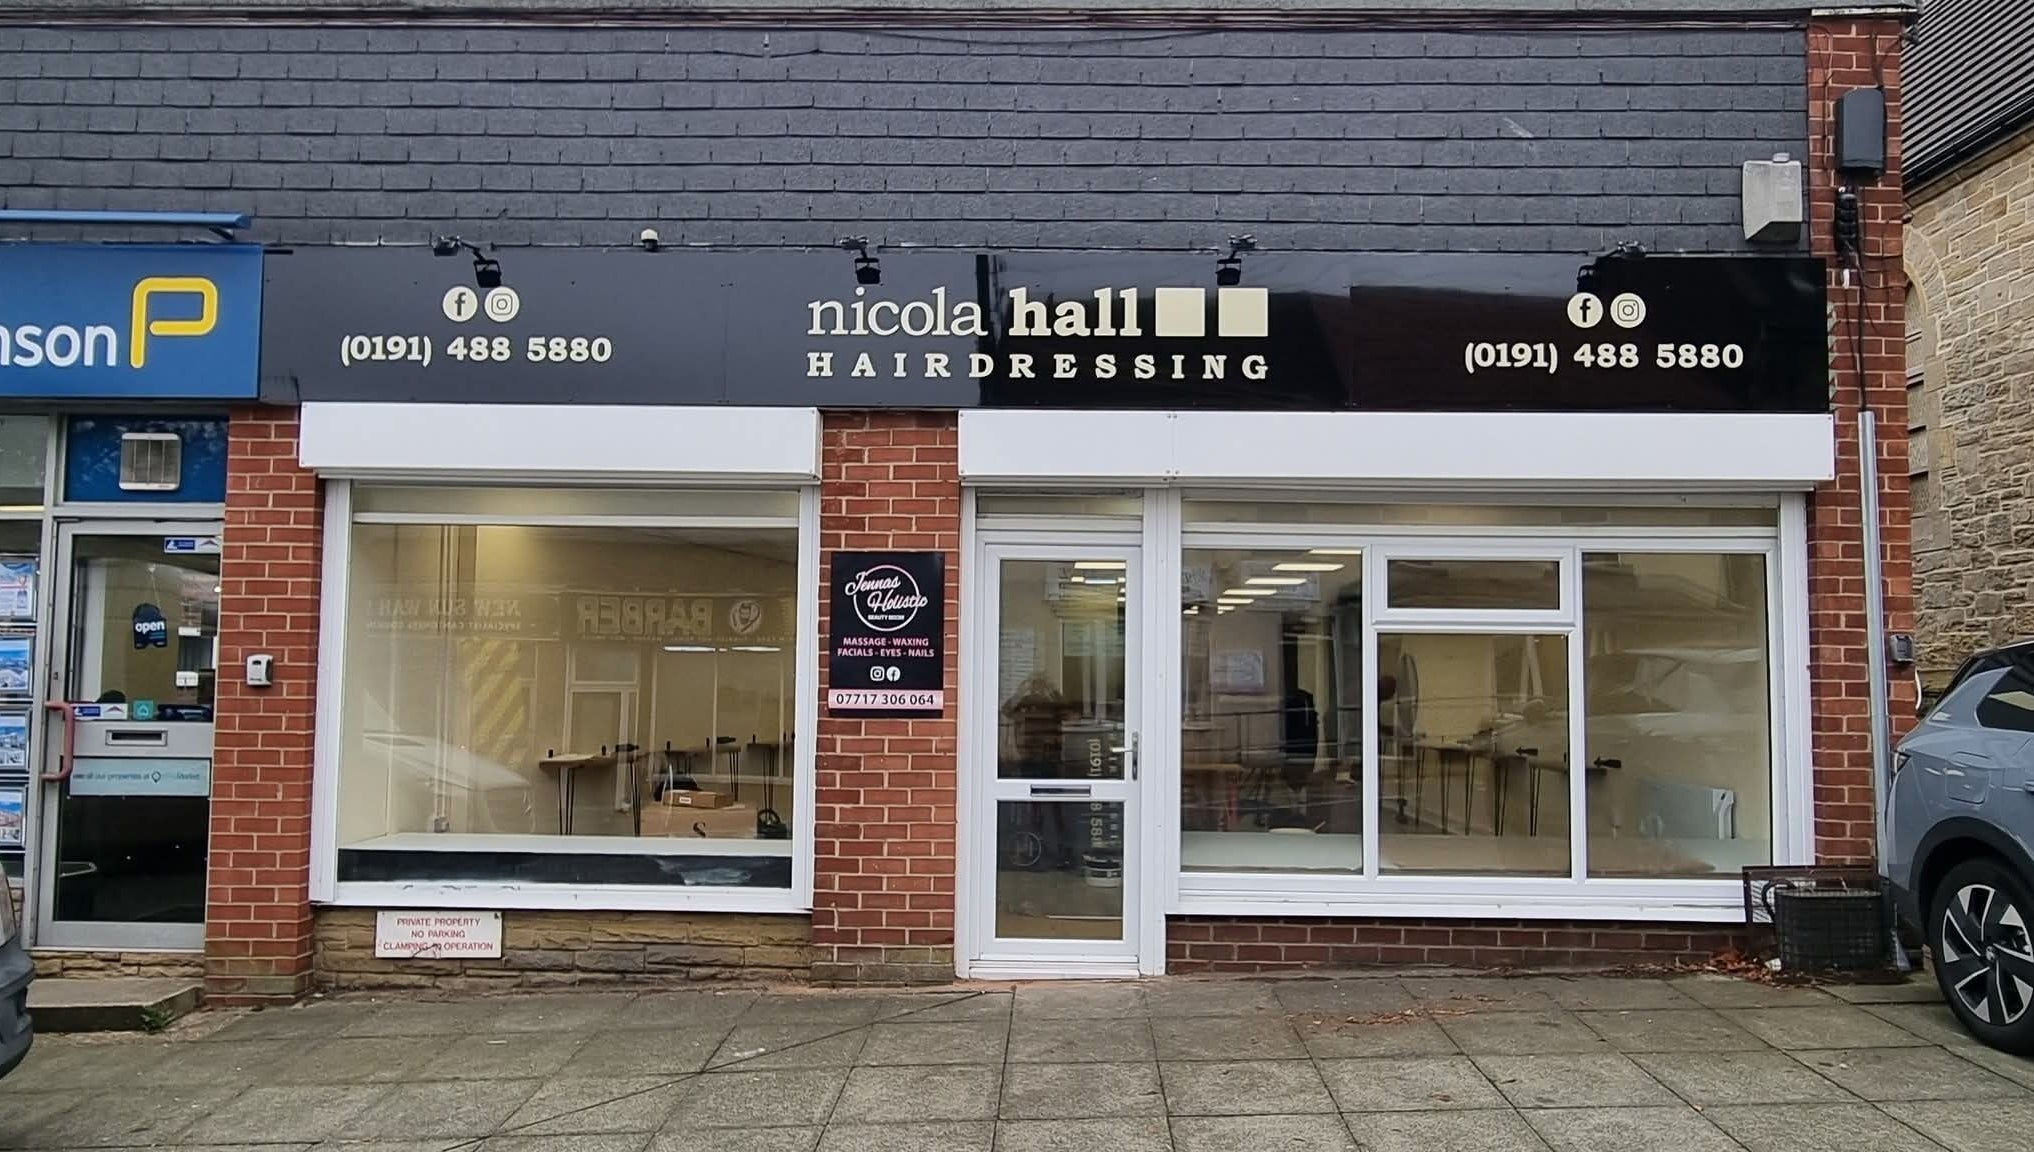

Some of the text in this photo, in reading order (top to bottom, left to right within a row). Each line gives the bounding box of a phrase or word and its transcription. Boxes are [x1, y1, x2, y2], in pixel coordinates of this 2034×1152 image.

[807, 287, 1142, 337] nicola hall
[341, 335, 612, 367] (0191) 488 5880
[1465, 342, 1744, 374] (0191) 488 5880
[807, 352, 1268, 379] HAIRDRESSING
[867, 589, 928, 613] Holistic
[135, 620, 165, 635] open
[843, 637, 929, 647] MASSAGE WAXING
[837, 647, 935, 657] FACIALS EYES NAILS
[836, 693, 935, 705] 07717 306 064
[397, 918, 481, 926] PRIVATE PROPERTY
[411, 930, 466, 939] NO PARKING
[383, 942, 428, 951] CLAMPING
[444, 942, 493, 951] OPERATION
